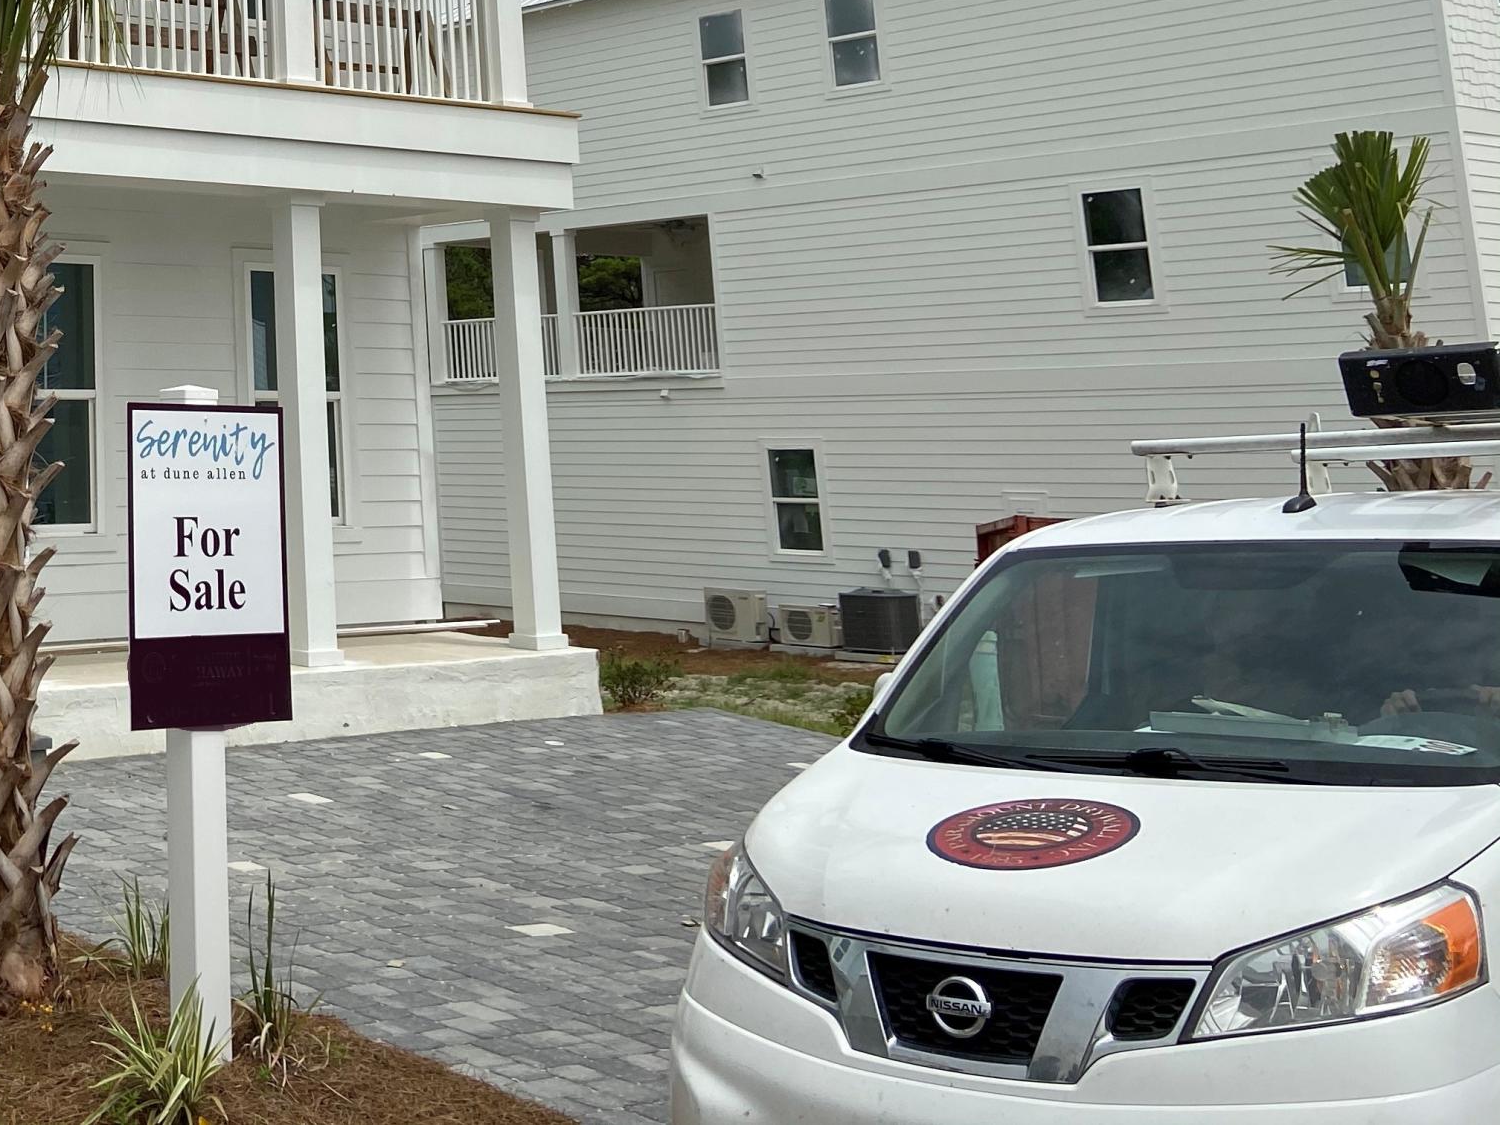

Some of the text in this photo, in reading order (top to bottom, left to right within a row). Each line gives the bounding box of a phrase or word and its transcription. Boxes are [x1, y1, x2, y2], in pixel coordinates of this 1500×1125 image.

[136, 420, 275, 480] Serenity
[140, 467, 247, 480] at dune allen
[173, 516, 241, 557] For
[169, 568, 246, 612] Sale
[930, 998, 982, 1015] NISSAN
